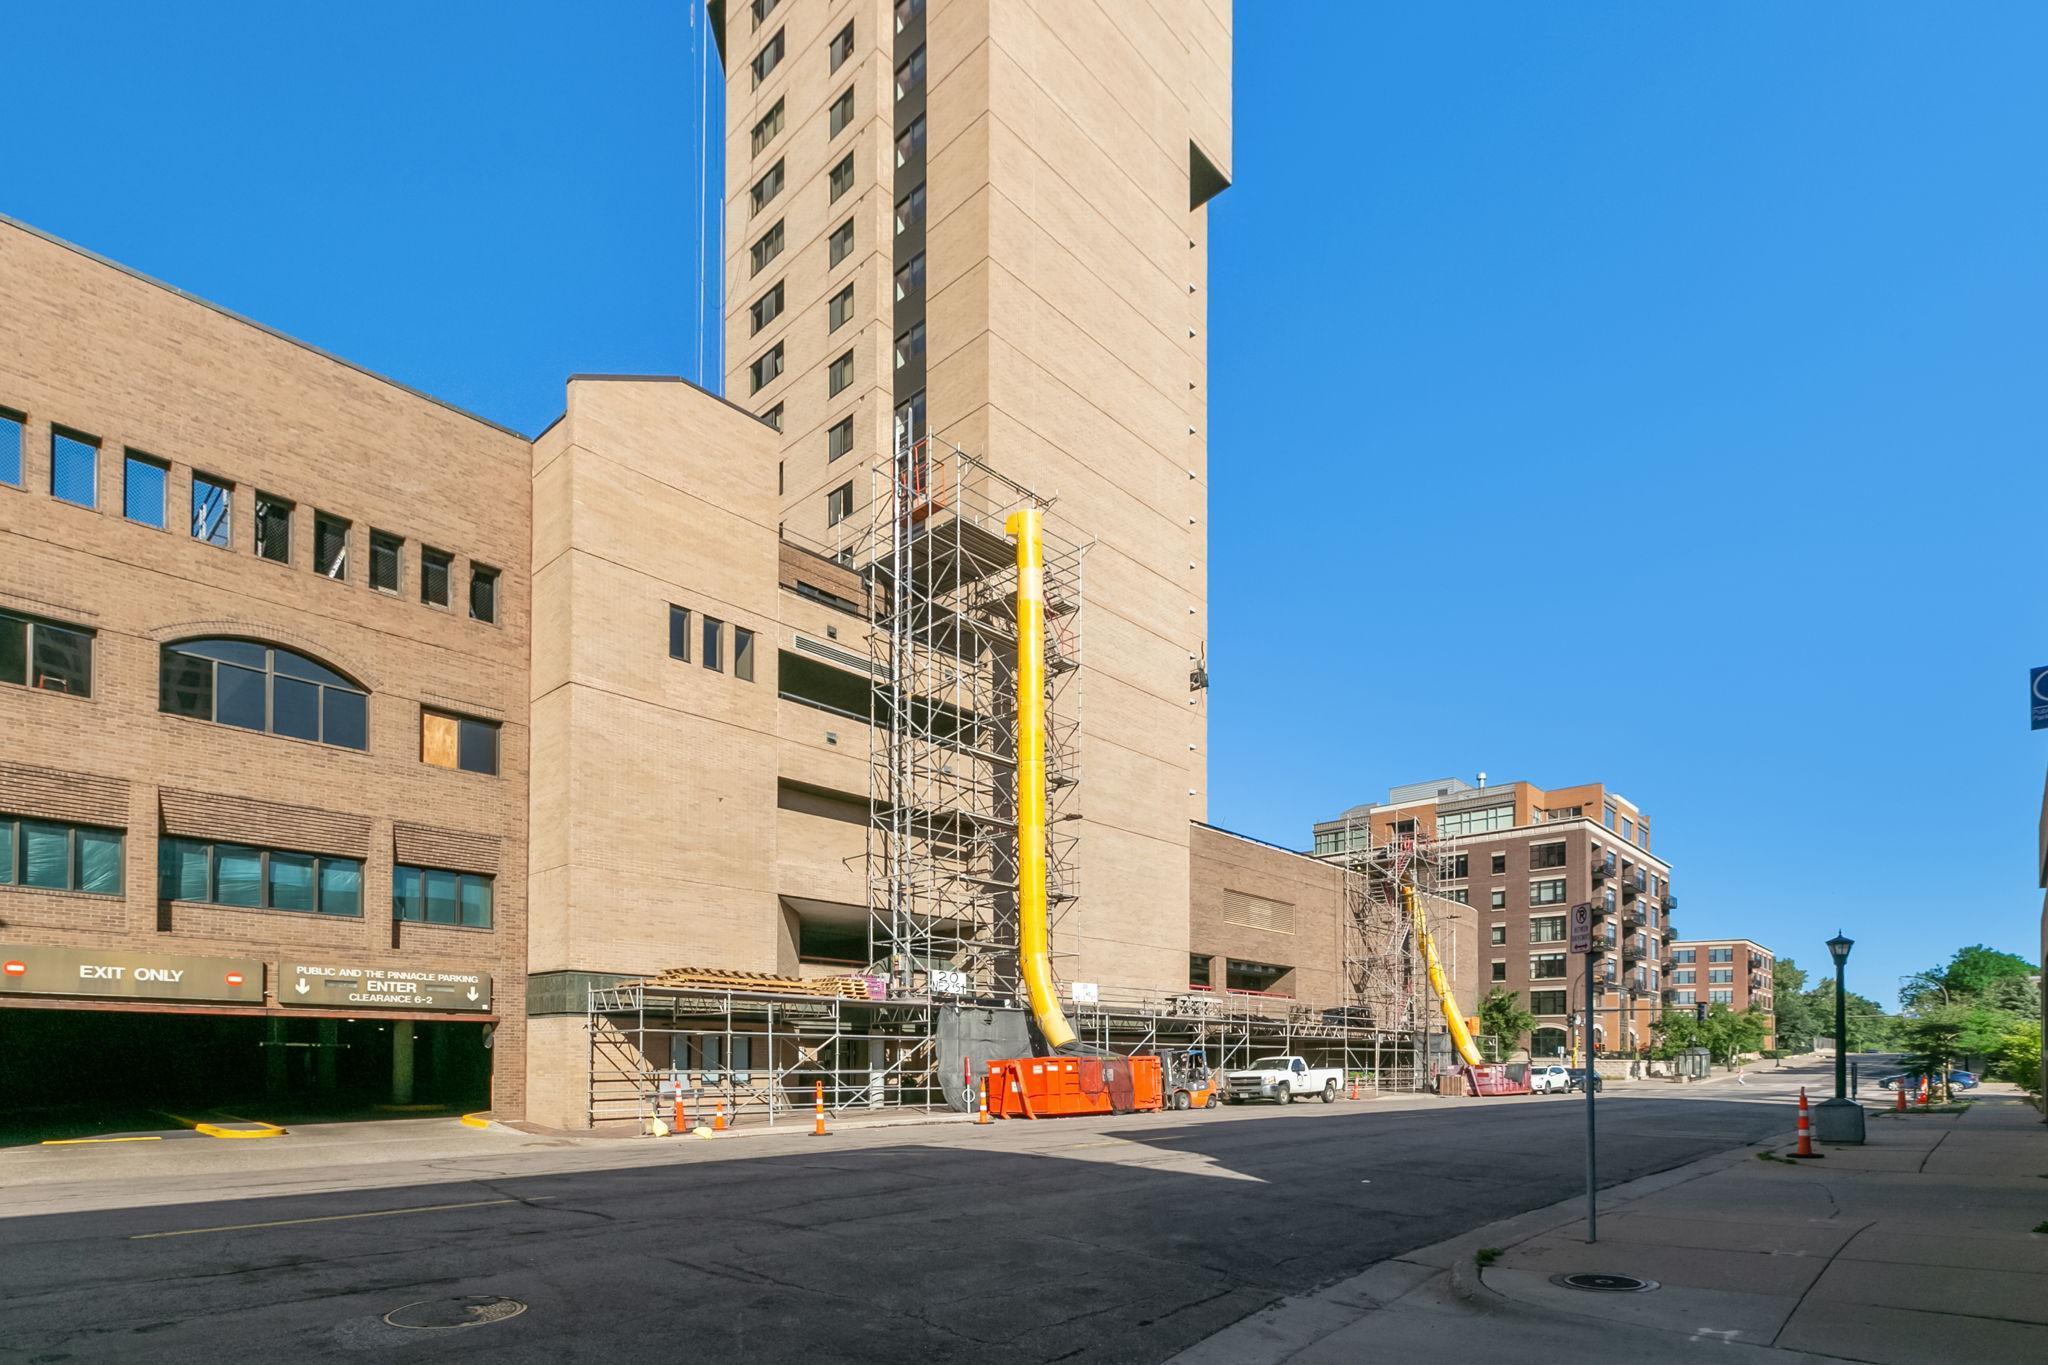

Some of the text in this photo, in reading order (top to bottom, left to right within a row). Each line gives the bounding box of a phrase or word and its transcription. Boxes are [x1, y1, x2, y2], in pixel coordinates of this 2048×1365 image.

[80, 965, 184, 982] EXIT ONLY
[296, 966, 479, 983] PUBLIC AND THE PINNACLE PARKING
[939, 971, 959, 983] 20
[367, 980, 417, 993] ENTER
[348, 993, 433, 1004] CLEARANCE 6-2
